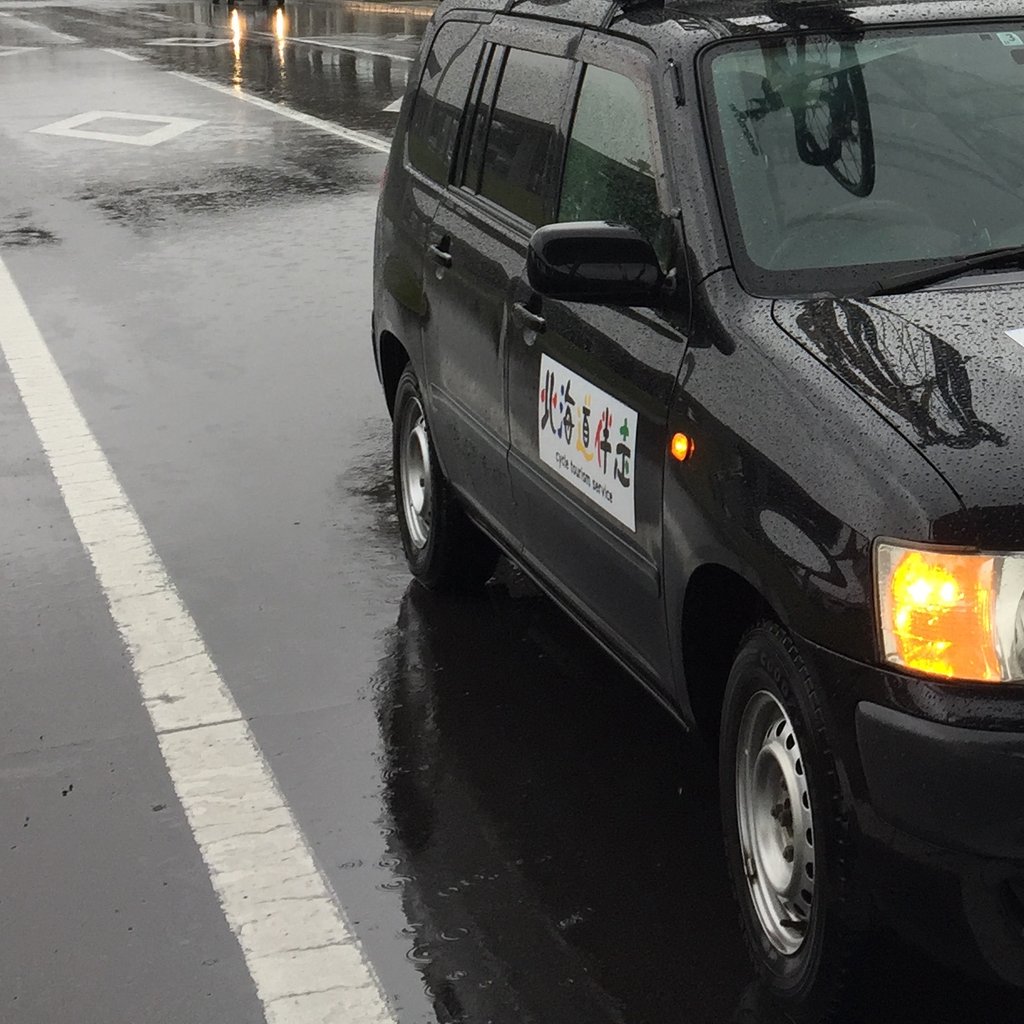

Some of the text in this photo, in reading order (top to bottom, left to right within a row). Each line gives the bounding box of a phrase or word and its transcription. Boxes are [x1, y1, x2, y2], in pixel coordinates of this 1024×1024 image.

[555, 451, 613, 503] cycle tourism service
